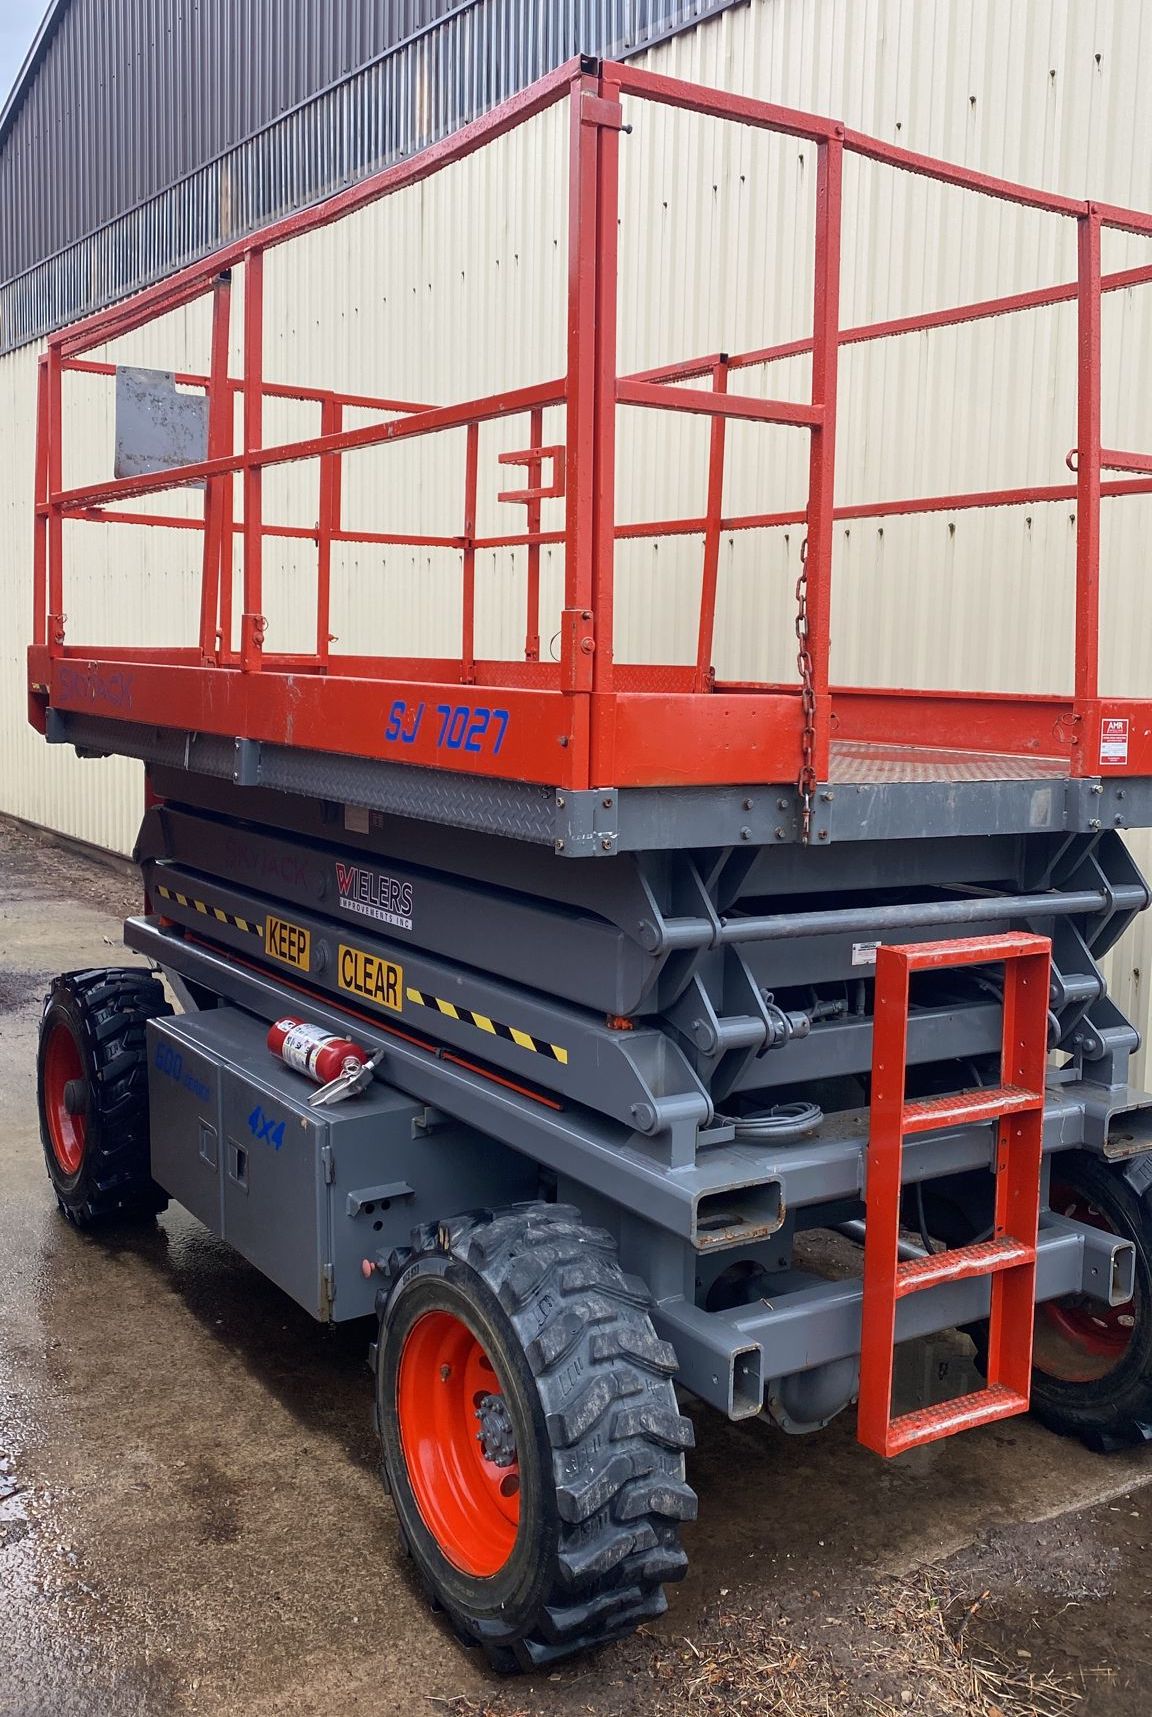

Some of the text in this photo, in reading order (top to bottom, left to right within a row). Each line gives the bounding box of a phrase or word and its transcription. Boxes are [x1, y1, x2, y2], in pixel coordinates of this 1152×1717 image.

[385, 700, 510, 754] SJ 7027
[335, 862, 413, 917] WIELERS
[341, 898, 393, 923] IMPROVEMENTS
[269, 918, 398, 1006] KEEP CLEAR
